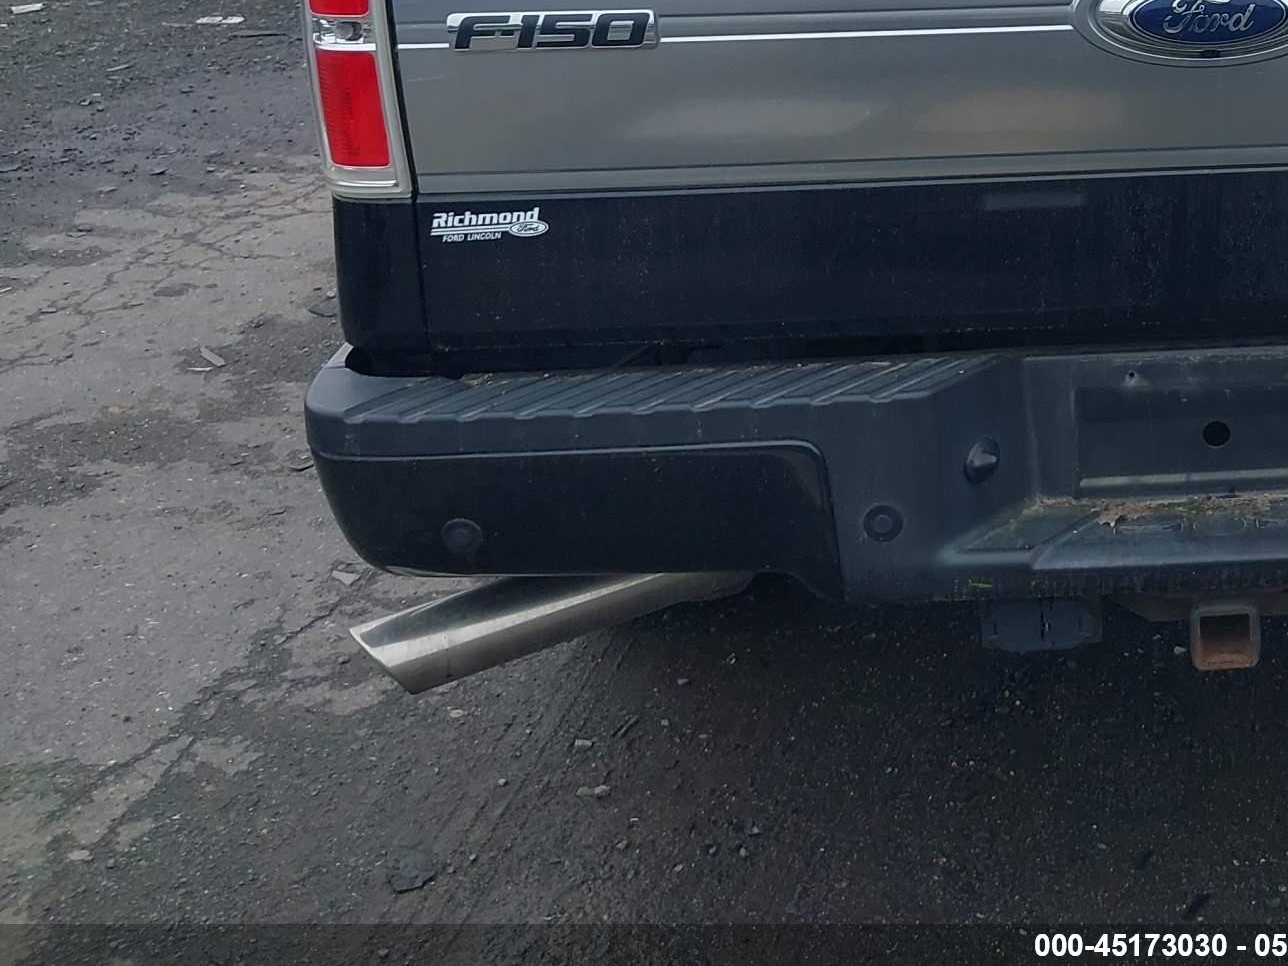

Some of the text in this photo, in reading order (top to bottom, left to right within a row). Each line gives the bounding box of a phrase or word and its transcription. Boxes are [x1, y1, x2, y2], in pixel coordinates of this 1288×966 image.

[454, 12, 651, 49] F-150
[432, 207, 540, 228] Richmond
[442, 232, 502, 243] FORD LINCOLN
